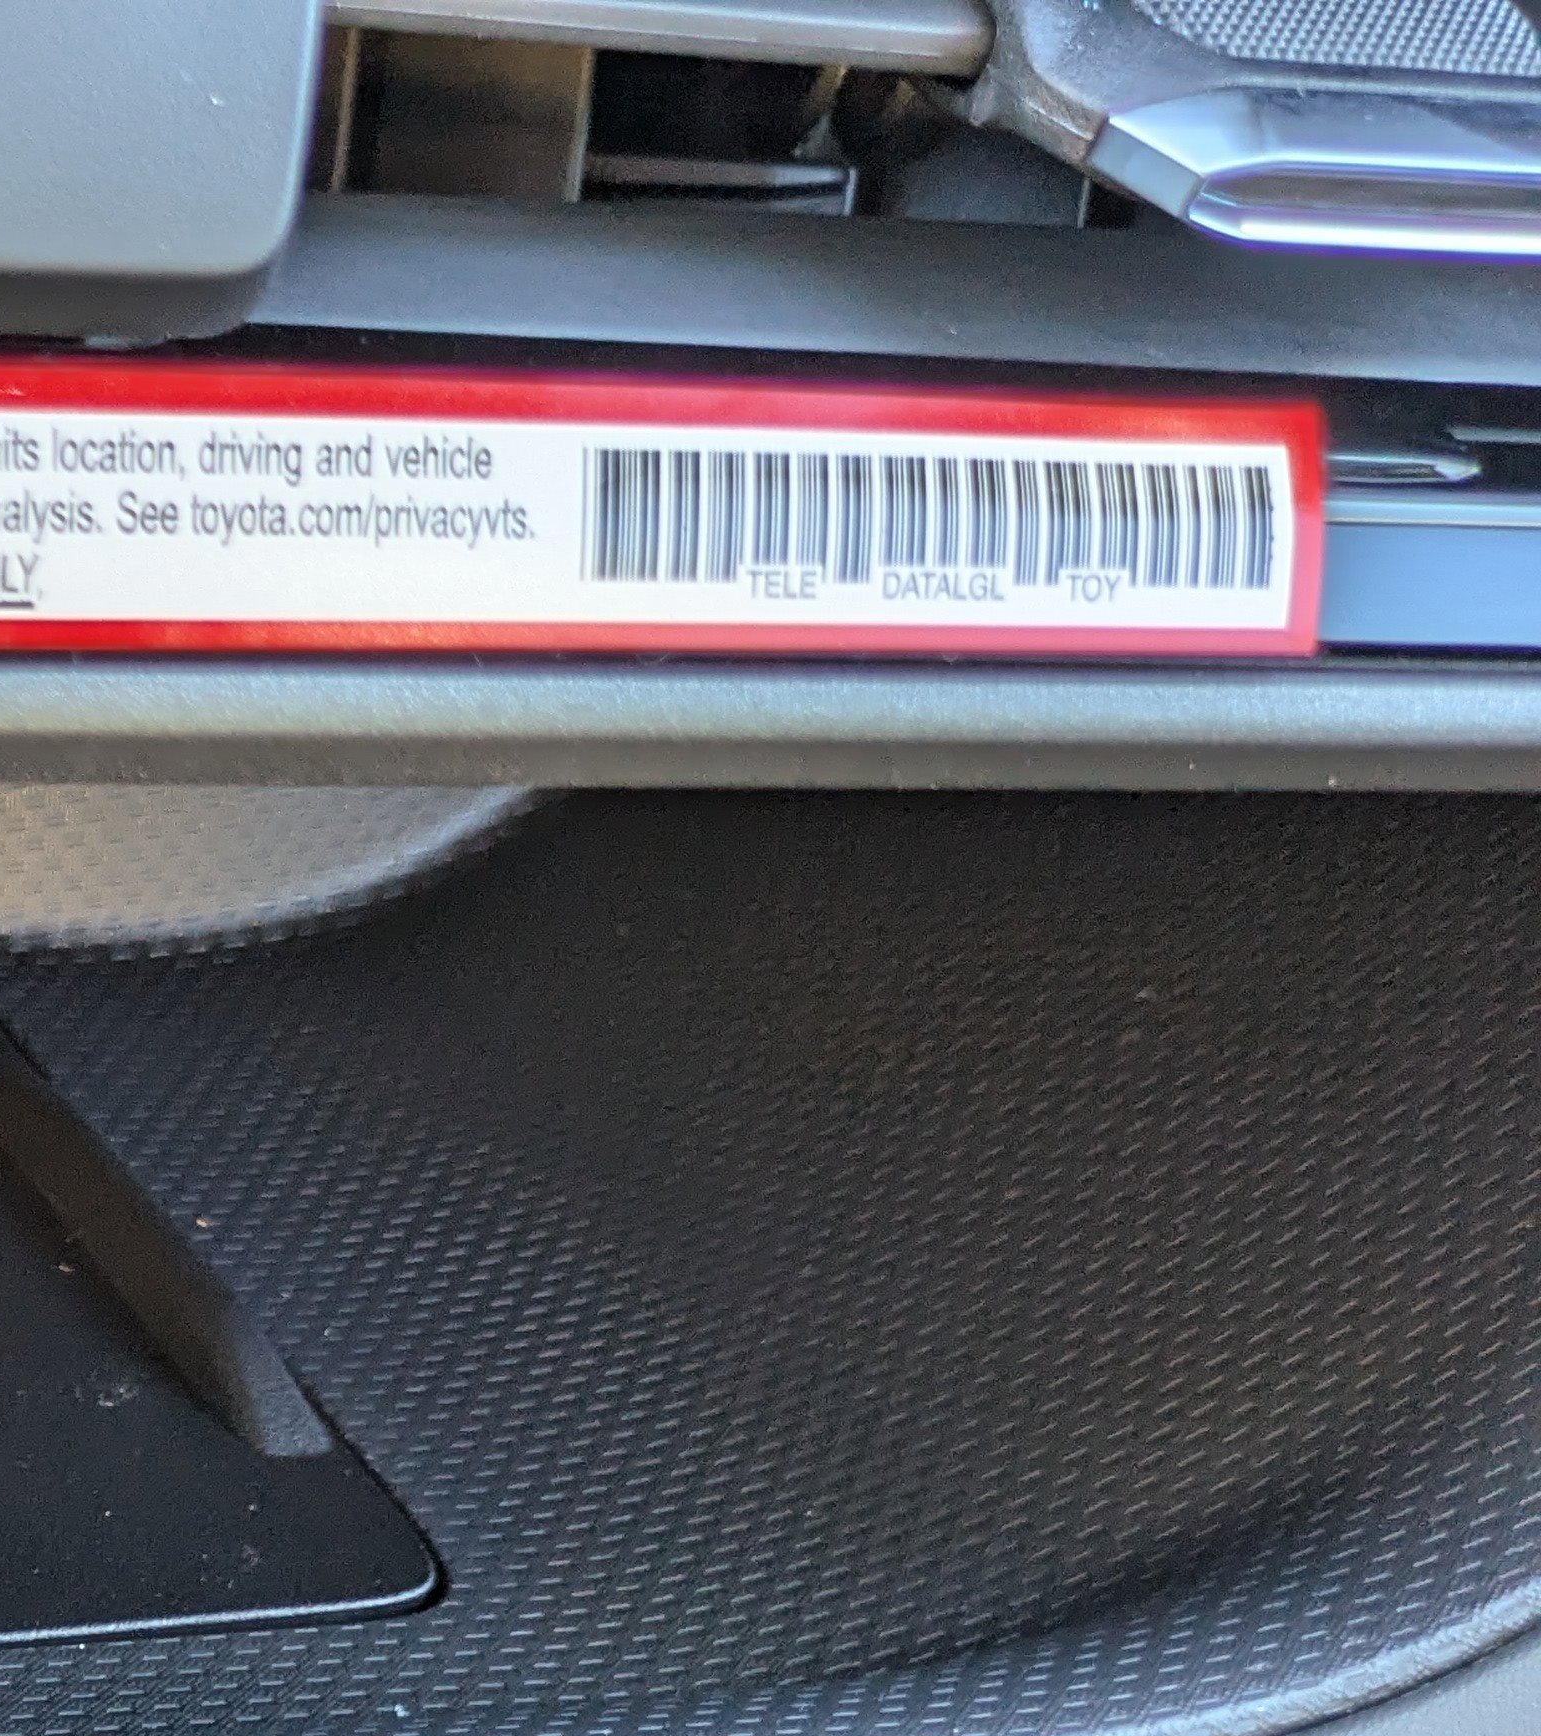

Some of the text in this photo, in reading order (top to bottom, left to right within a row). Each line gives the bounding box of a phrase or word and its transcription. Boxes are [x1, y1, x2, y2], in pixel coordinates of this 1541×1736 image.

[49, 423, 186, 480] location,
[198, 429, 303, 487] driving
[315, 434, 374, 481] and
[384, 433, 494, 482] vehicle
[116, 491, 179, 535] See
[190, 494, 536, 550] toyota.com/privacyvts.
[748, 571, 1124, 604] TELE DATALGL TOY
